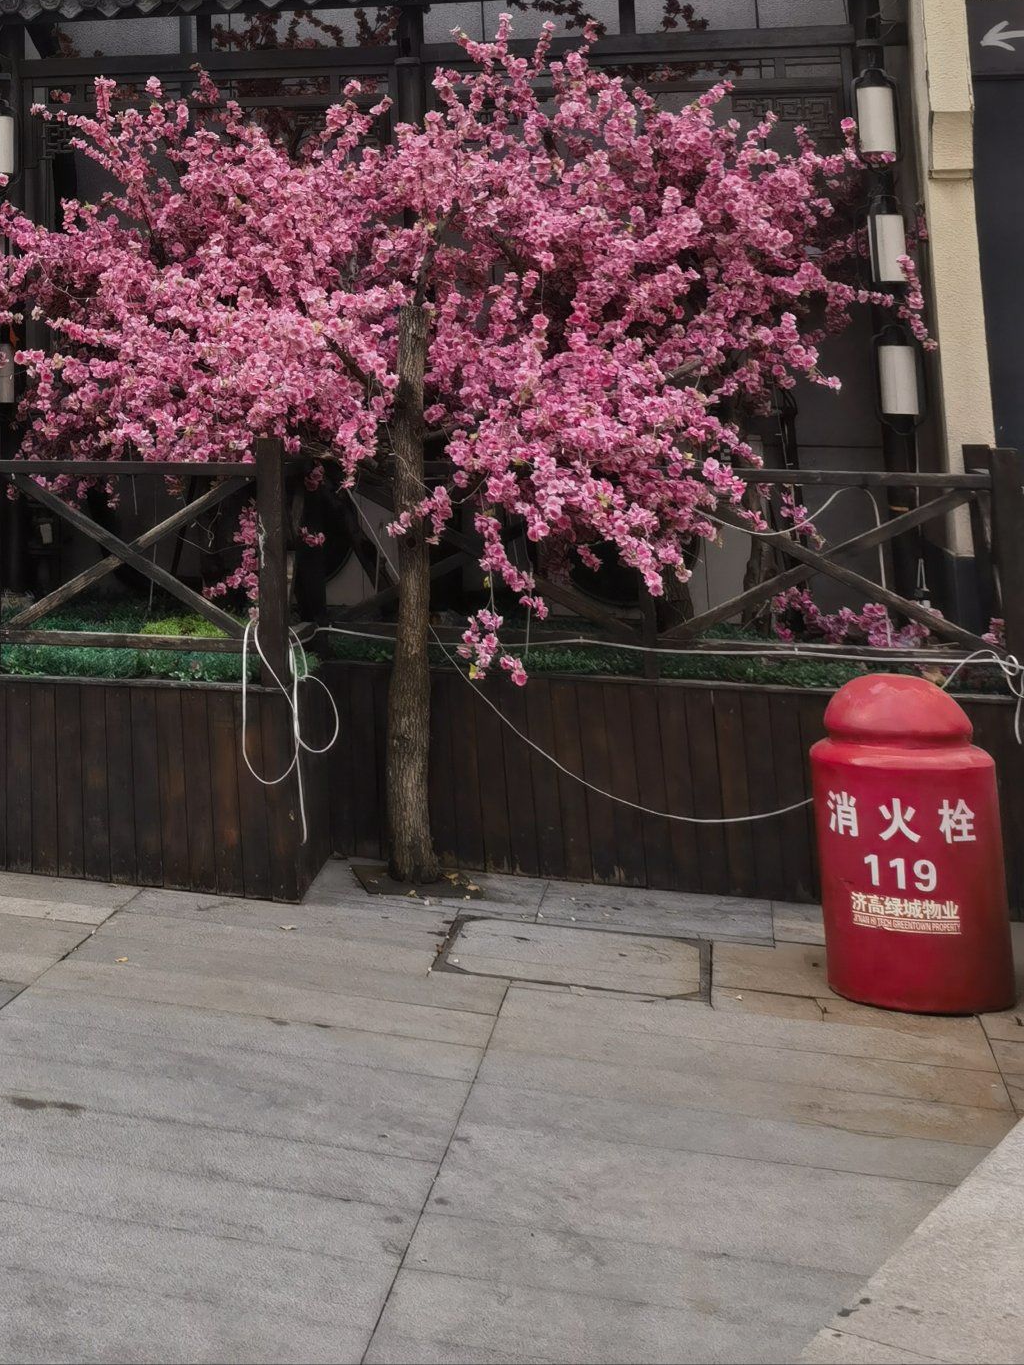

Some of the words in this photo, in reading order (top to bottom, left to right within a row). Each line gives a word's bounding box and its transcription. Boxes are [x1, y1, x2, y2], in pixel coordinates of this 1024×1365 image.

[826, 789, 977, 844] 消火栓
[863, 853, 938, 893] 119
[851, 891, 961, 920] 济高绿城物业
[893, 919, 932, 931] GREENTOWN
[932, 922, 961, 932] PROPERTY
